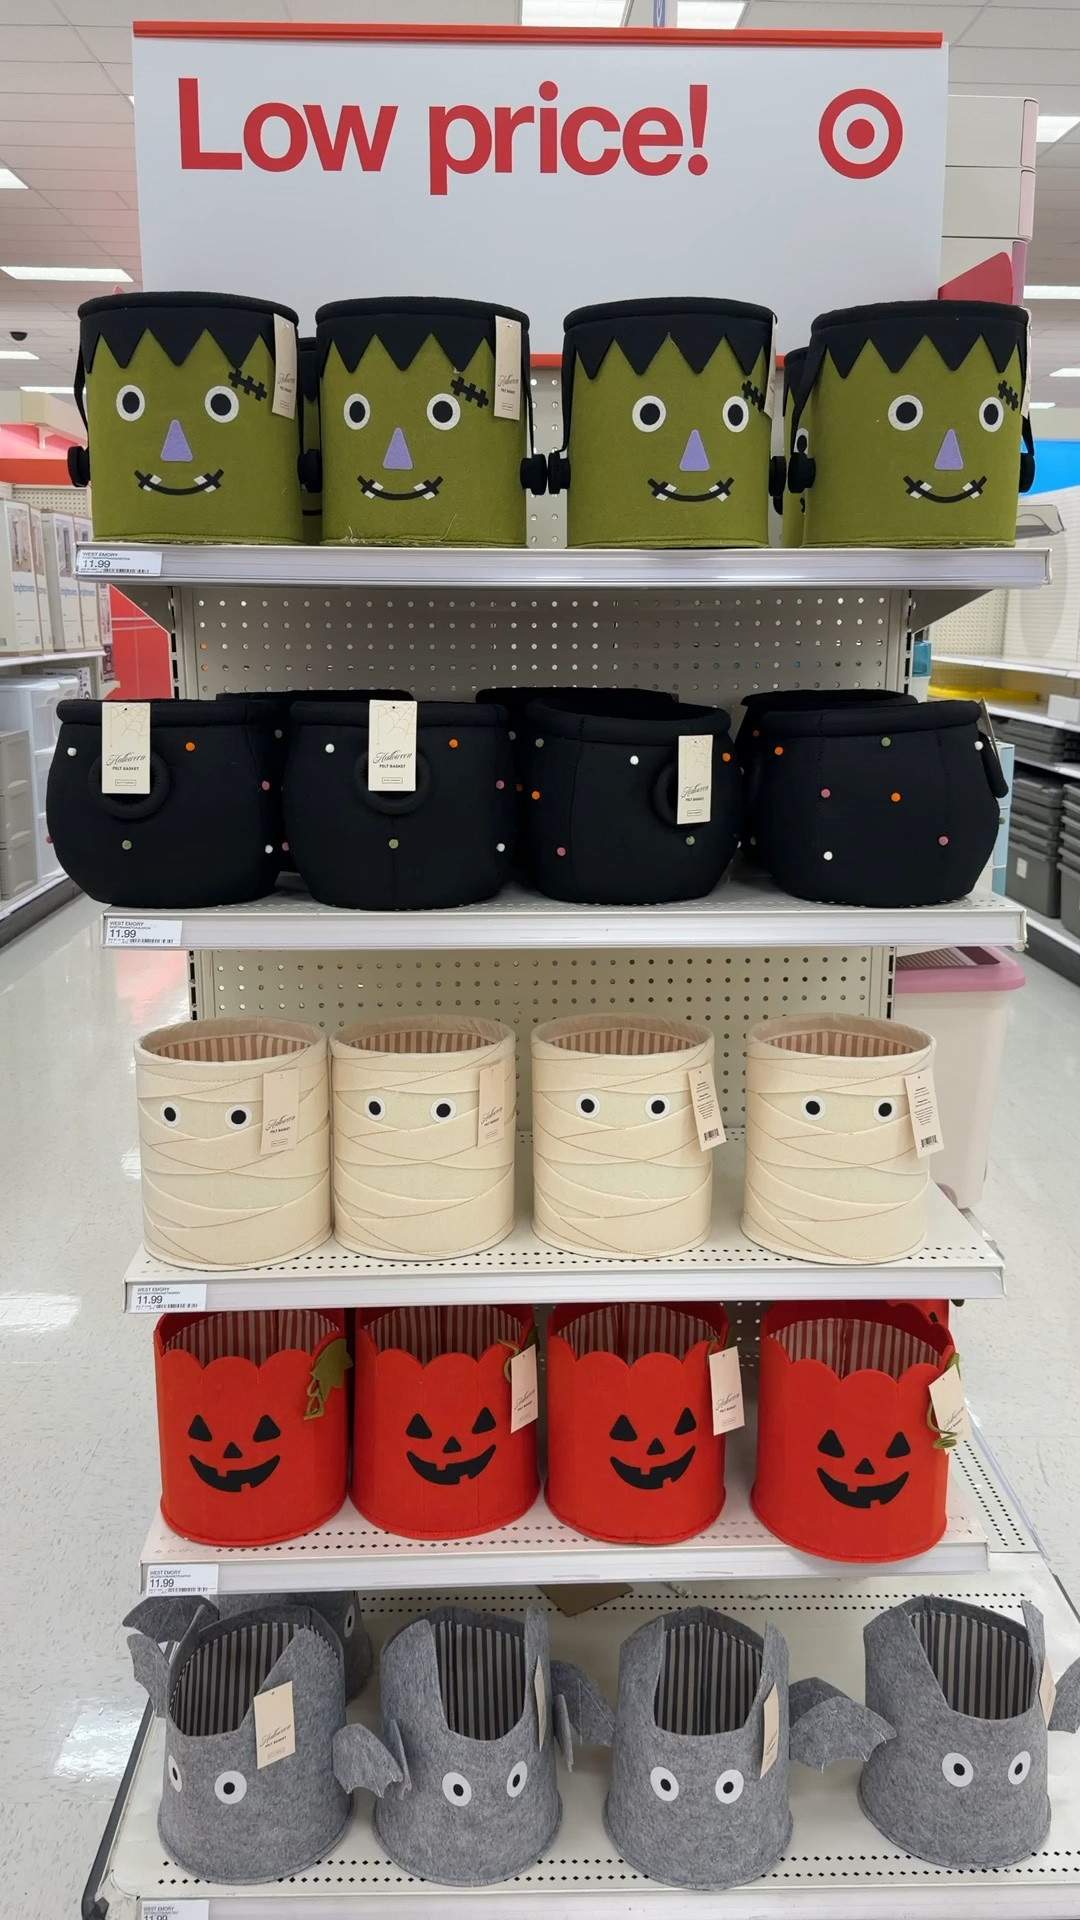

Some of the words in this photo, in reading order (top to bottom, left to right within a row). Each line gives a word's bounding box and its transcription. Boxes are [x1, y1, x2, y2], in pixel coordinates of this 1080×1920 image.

[178, 77, 399, 172] Low
[428, 80, 709, 196] price!
[83, 560, 111, 568] 11.99
[110, 929, 137, 938] 11.99
[137, 1295, 163, 1304] 11.99
[150, 1578, 174, 1587] 11.99
